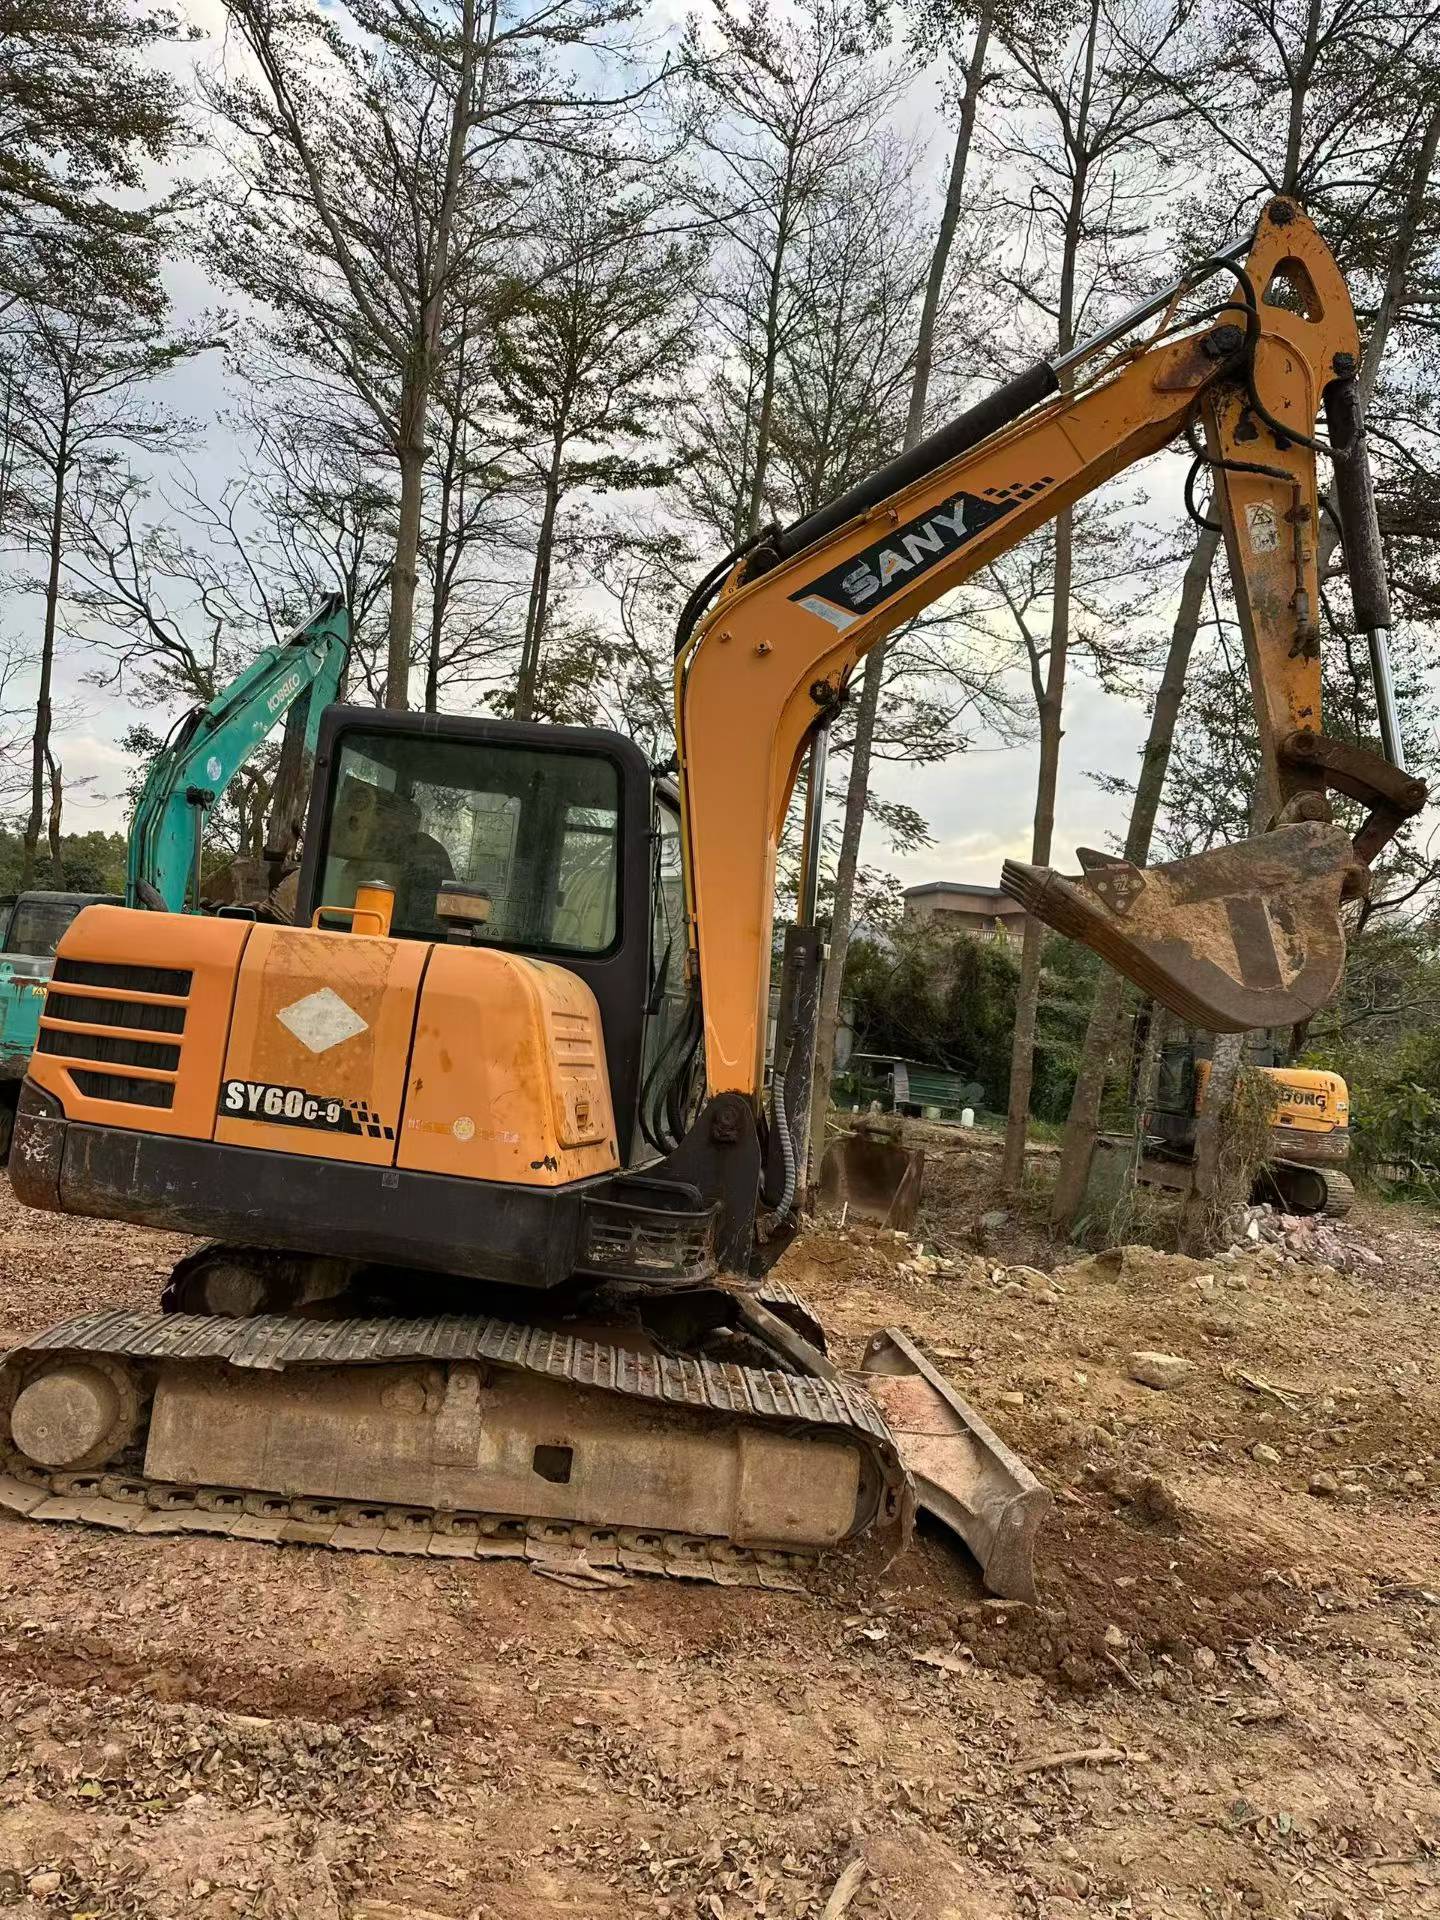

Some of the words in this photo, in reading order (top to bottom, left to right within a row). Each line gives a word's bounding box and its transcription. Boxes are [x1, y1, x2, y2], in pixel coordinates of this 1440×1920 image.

[841, 499, 968, 606] SANY
[266, 672, 300, 713] KOBELCO
[1279, 1089, 1327, 1109] GONG
